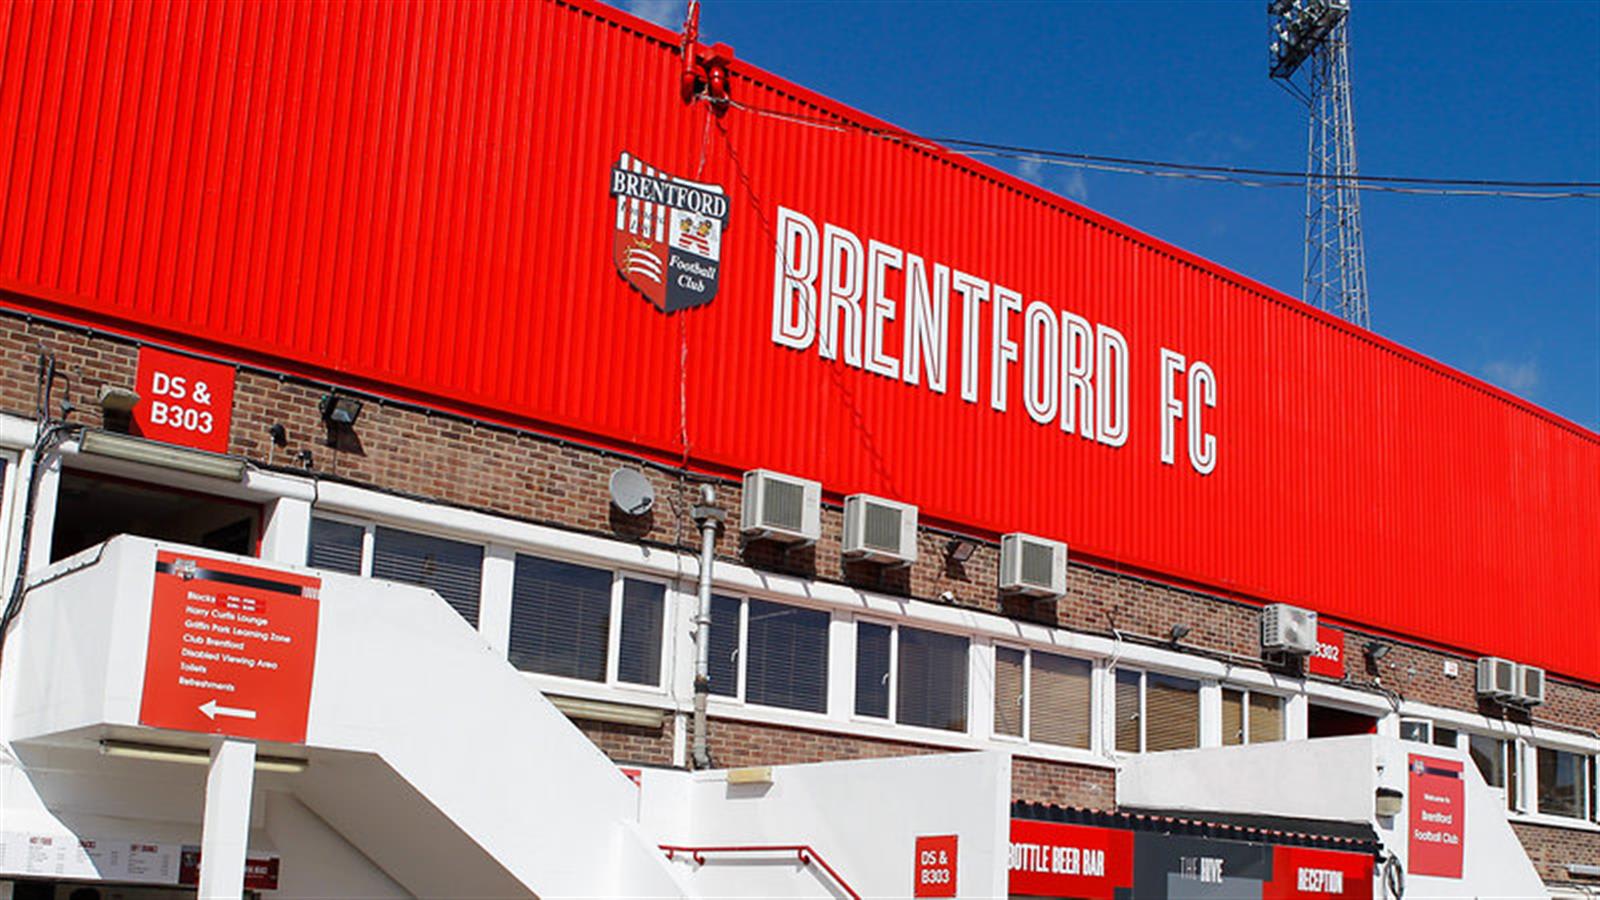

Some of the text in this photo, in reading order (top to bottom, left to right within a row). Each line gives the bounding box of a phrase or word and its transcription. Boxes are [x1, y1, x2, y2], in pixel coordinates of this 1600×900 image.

[613, 170, 726, 218] BRENTFORD
[669, 254, 717, 280] Football
[677, 273, 705, 293] Club
[771, 205, 1217, 476] BRENTFORD FC
[152, 371, 212, 406] DS &
[150, 401, 214, 434] B303
[187, 592, 216, 604] Blocks
[186, 606, 268, 626] Harry Curtis Lounge
[185, 620, 291, 642] Griffin Park Learning Zone
[183, 634, 244, 650] Club Brentford
[181, 648, 278, 670] Disabled Viewing Area
[181, 662, 207, 672] Toilets
[179, 676, 235, 692] Refreshments
[1422, 810, 1452, 824] Brentford
[1414, 828, 1458, 844] Football Club
[921, 850, 948, 866] DS &
[1008, 842, 1105, 877] BOTTLE BEER BAR
[921, 868, 950, 884] B303
[1180, 856, 1225, 883] THE HIVE
[1297, 866, 1344, 894] RECEPTION
